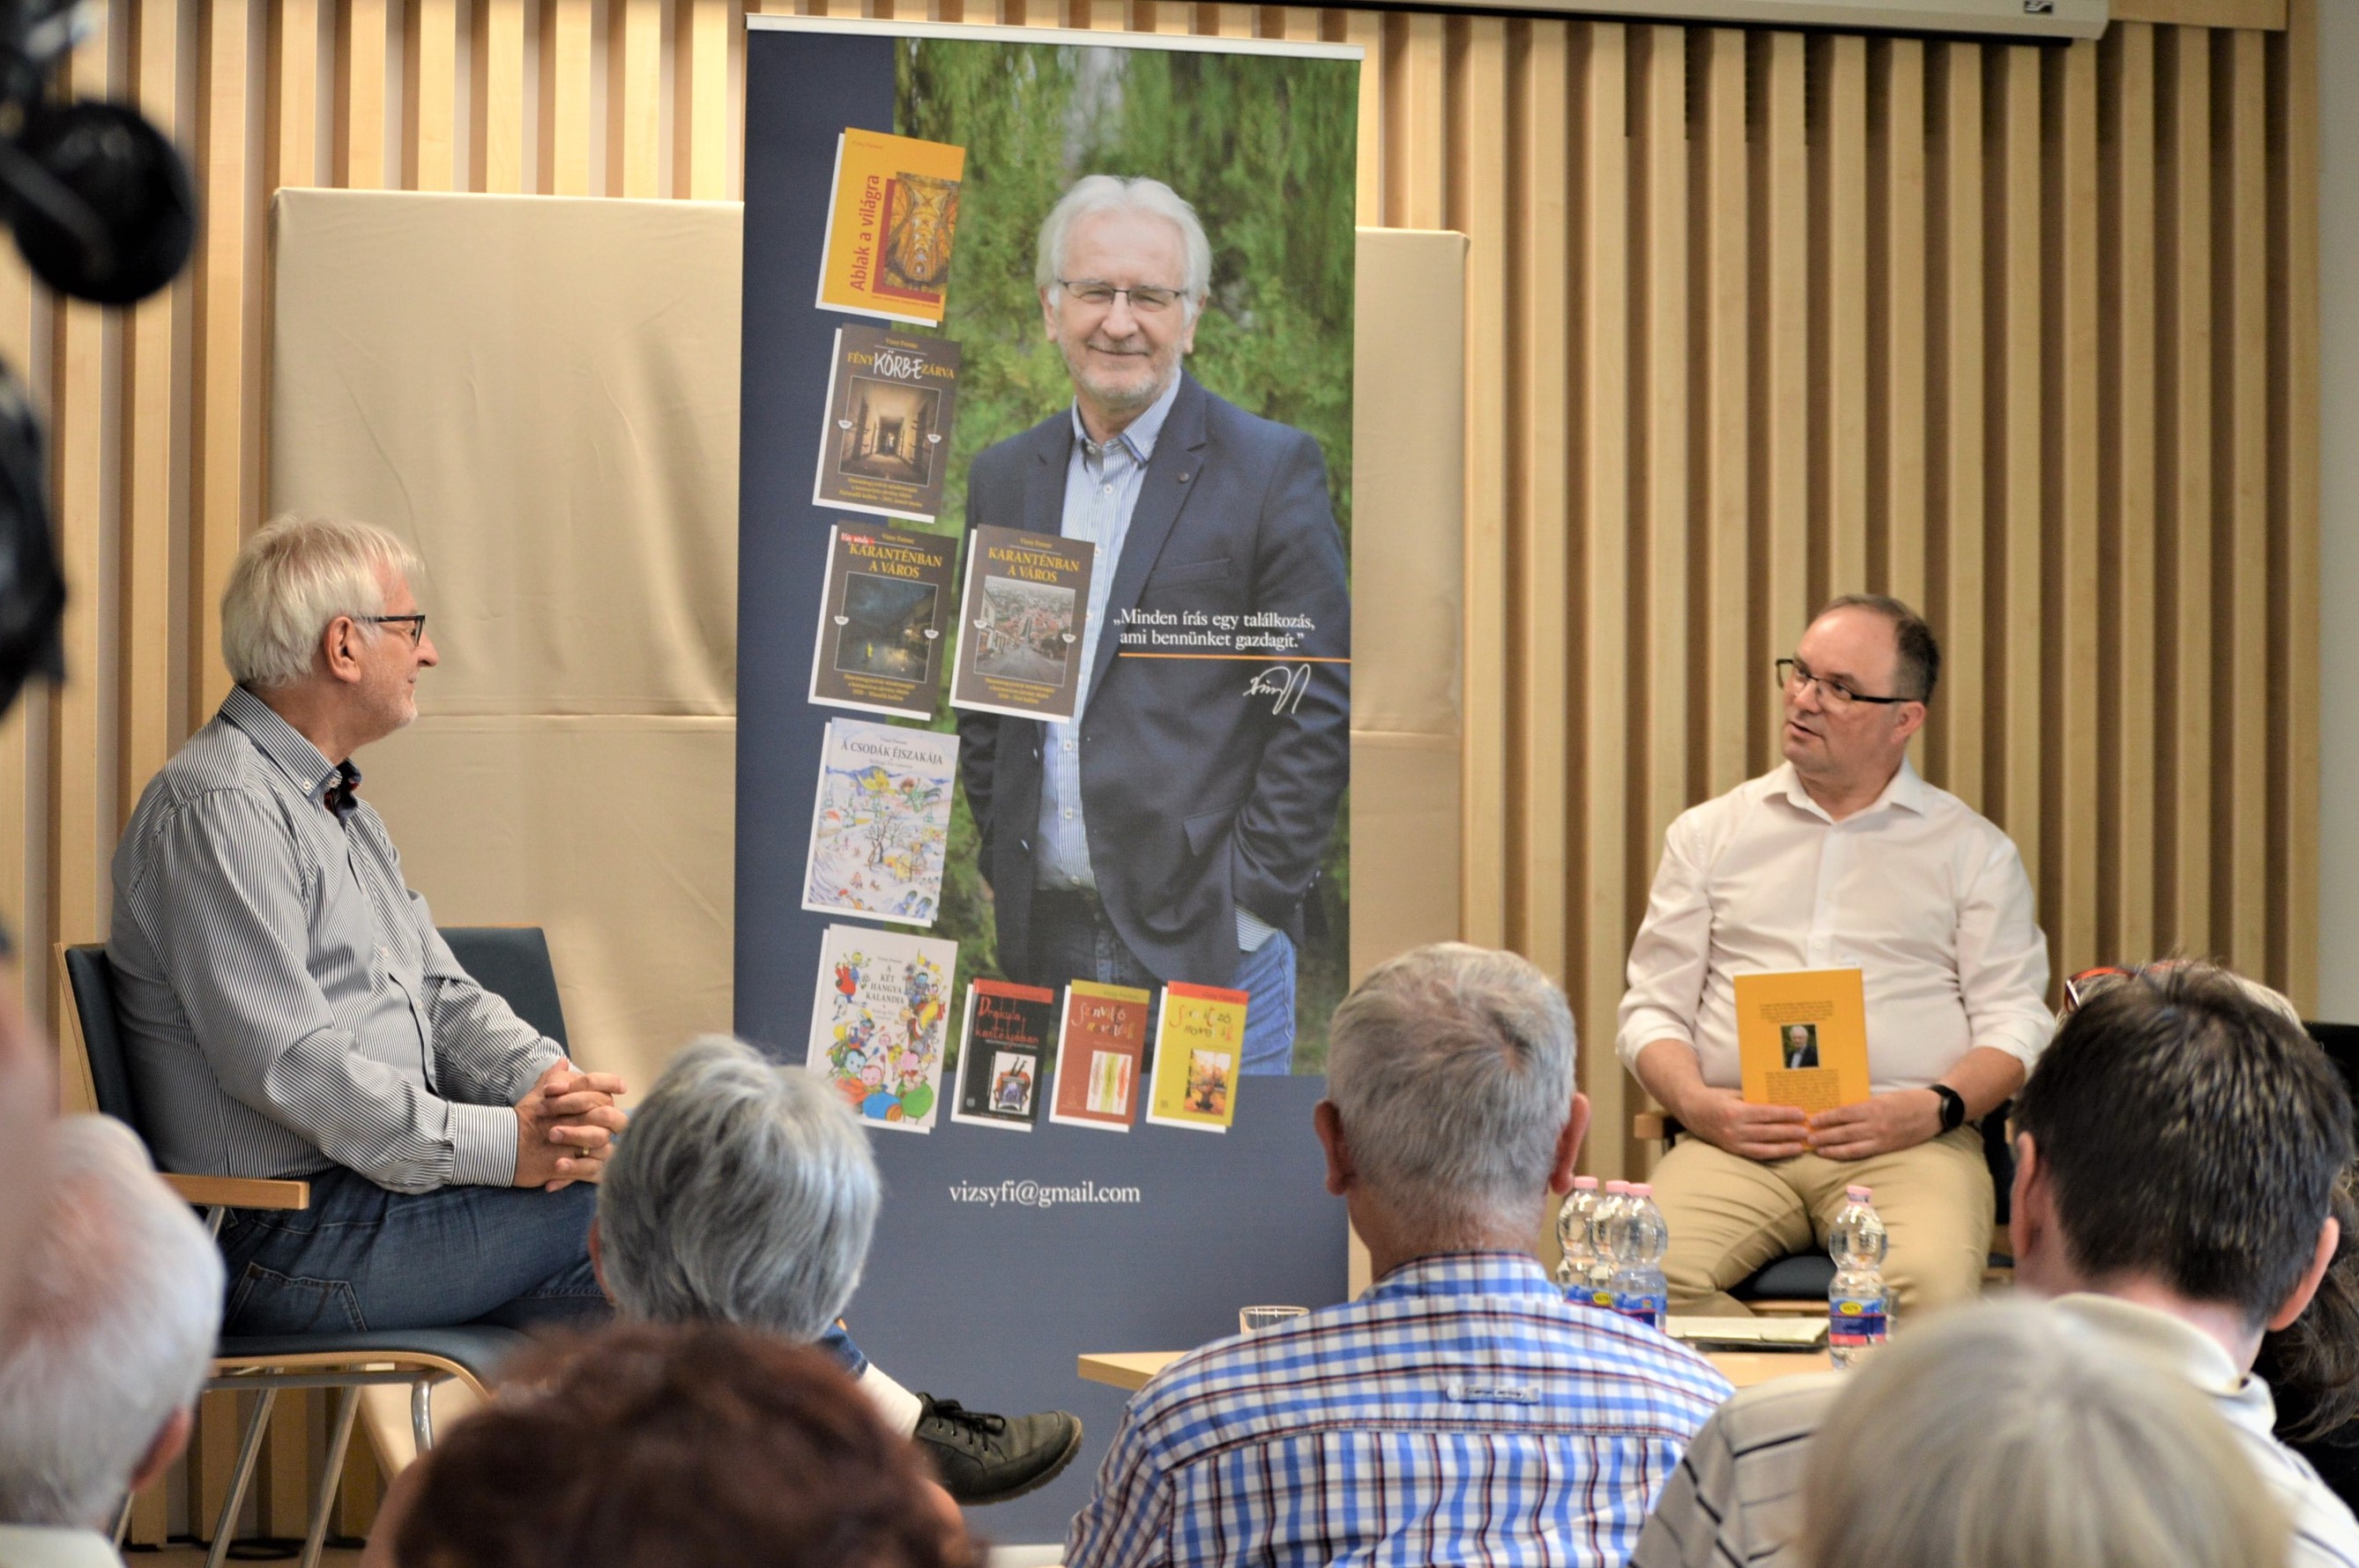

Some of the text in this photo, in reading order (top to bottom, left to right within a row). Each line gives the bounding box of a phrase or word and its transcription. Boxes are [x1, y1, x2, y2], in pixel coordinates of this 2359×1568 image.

[850, 175, 882, 292] Ablak a világra
[849, 544, 942, 568] KARANTÉNBAN
[988, 546, 1080, 572] KARANTÉNBAN
[868, 561, 920, 578] A VÁROS
[1008, 565, 1058, 582] A VÁROS
[1182, 610, 1208, 626] írás
[1212, 614, 1239, 630] egy
[1244, 612, 1315, 630] találkozás,
[1120, 629, 1147, 644] ami
[1151, 629, 1231, 646] bennünket
[841, 740, 848, 751] A
[850, 742, 889, 757] CSODÁK
[892, 747, 942, 765] ÉJSZAKÁJA
[870, 982, 902, 994] HANGYA
[949, 1179, 1141, 1208] vizsyfi@gmail.com
